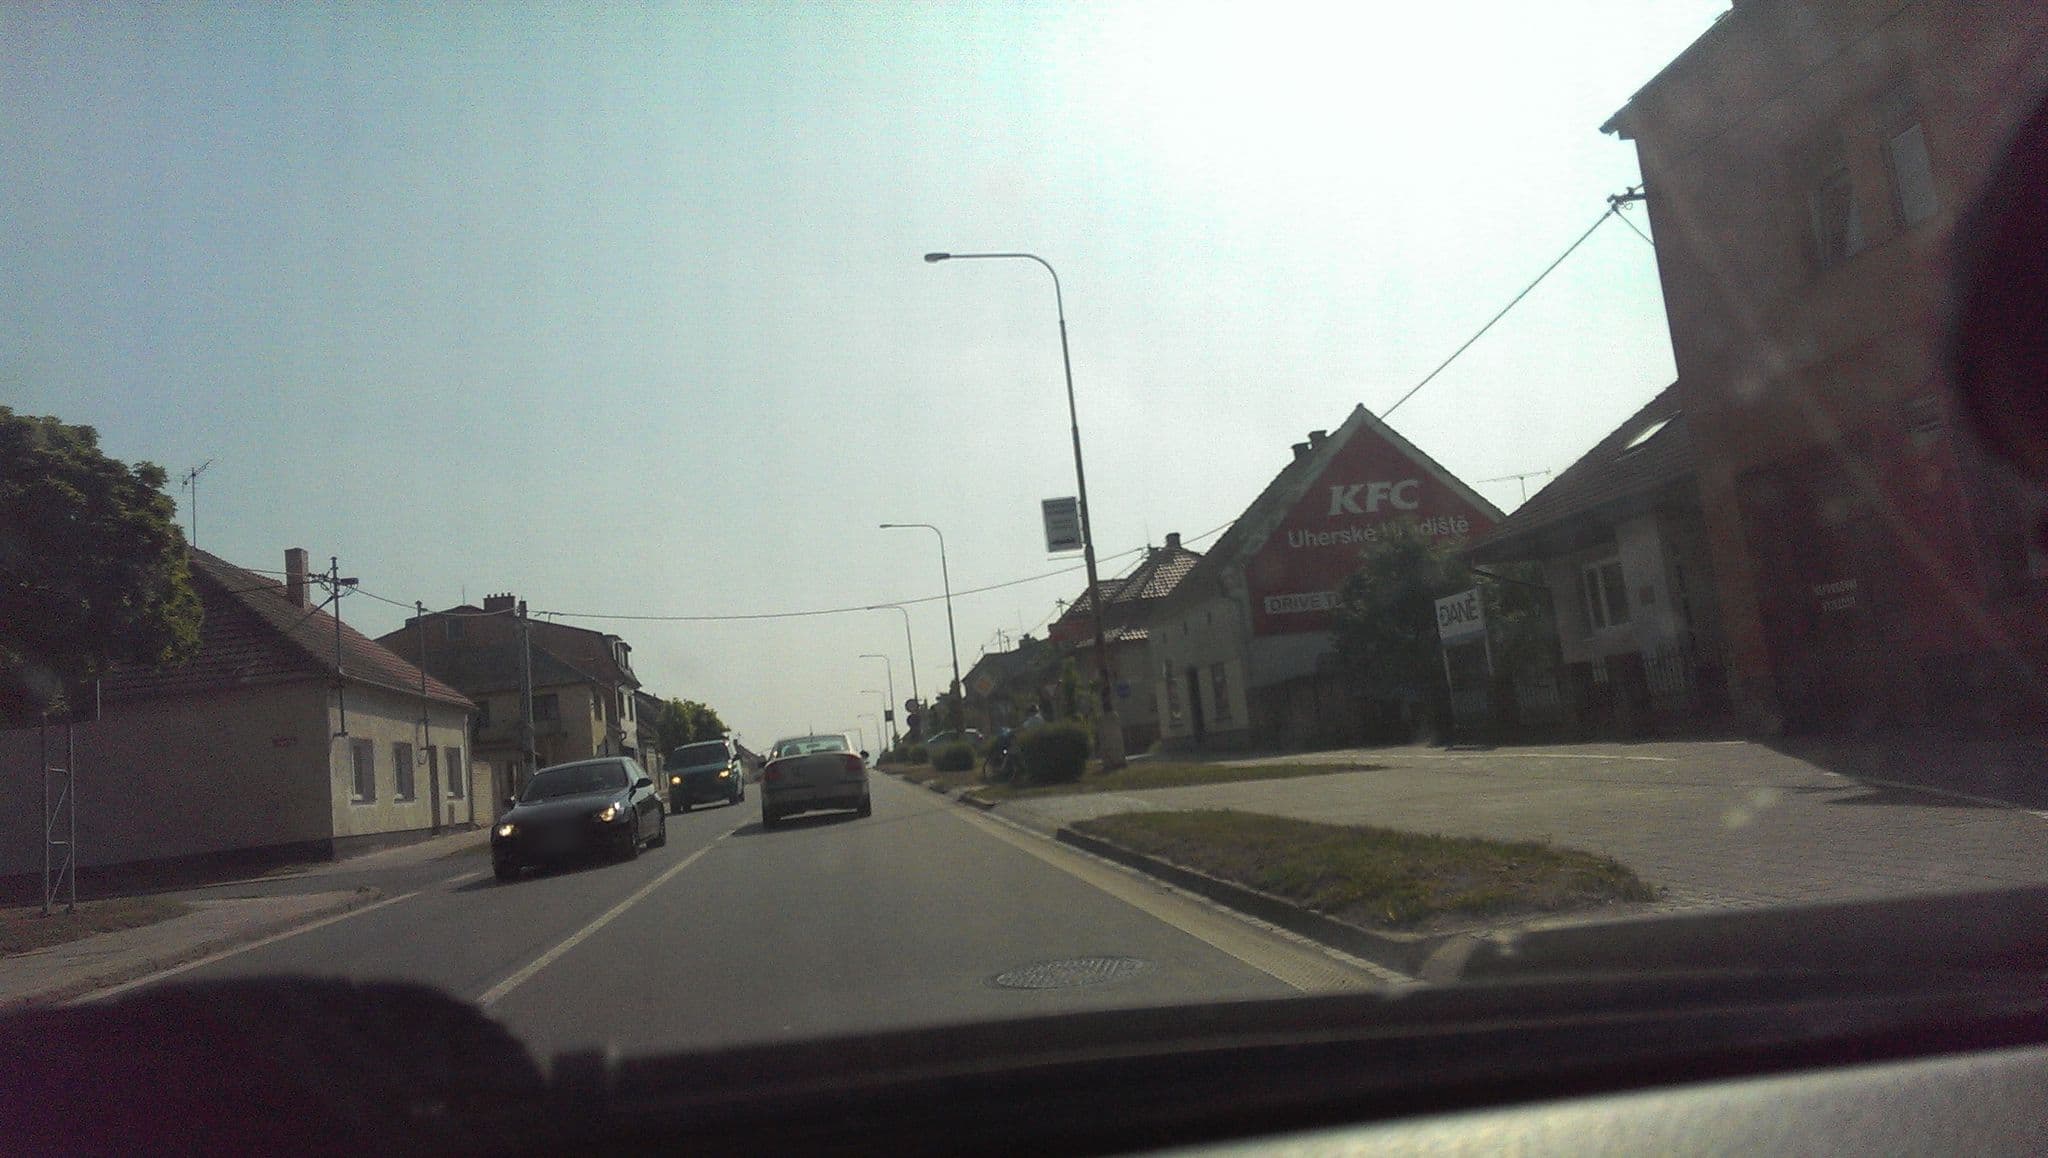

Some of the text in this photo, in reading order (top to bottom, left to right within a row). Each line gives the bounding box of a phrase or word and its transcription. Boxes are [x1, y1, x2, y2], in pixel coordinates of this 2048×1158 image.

[1328, 479, 1419, 516] KFC
[1287, 524, 1378, 548] Uherské
[1270, 594, 1321, 611] DRIVE
